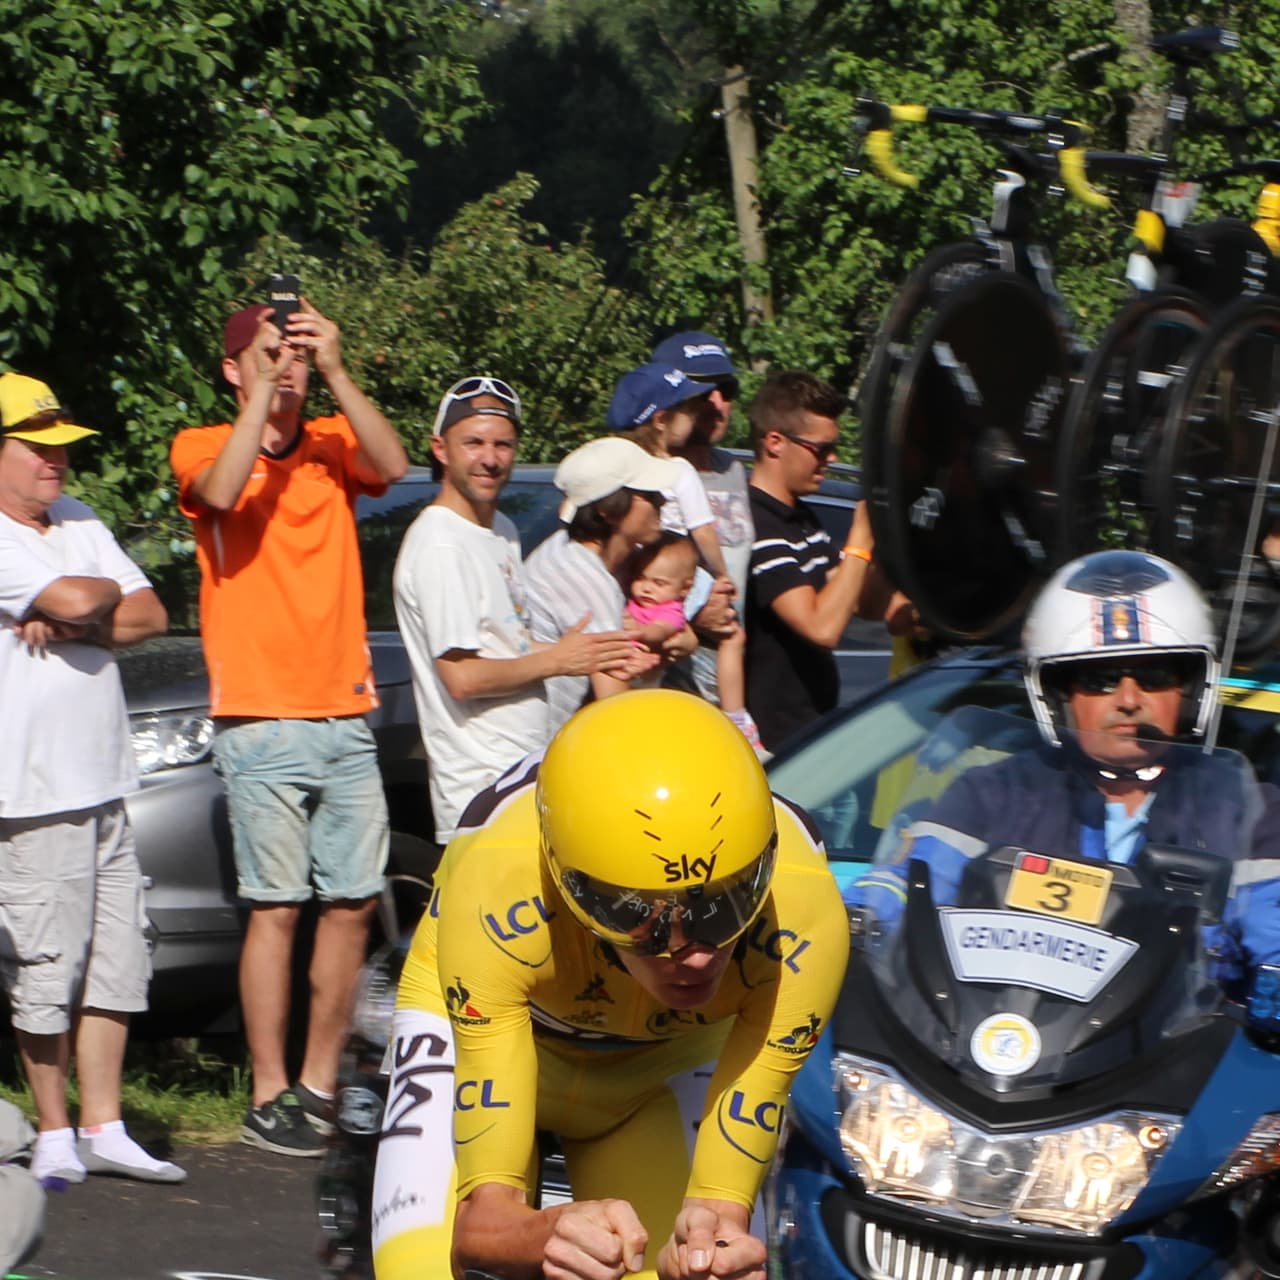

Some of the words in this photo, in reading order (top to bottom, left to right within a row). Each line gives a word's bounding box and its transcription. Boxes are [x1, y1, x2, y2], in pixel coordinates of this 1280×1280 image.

[663, 853, 717, 884] sky
[1037, 881, 1072, 912] 3
[484, 895, 556, 941] LCL
[748, 916, 811, 974] LCL
[959, 925, 1109, 973] GENDARMERIE
[453, 1079, 511, 1112] CL
